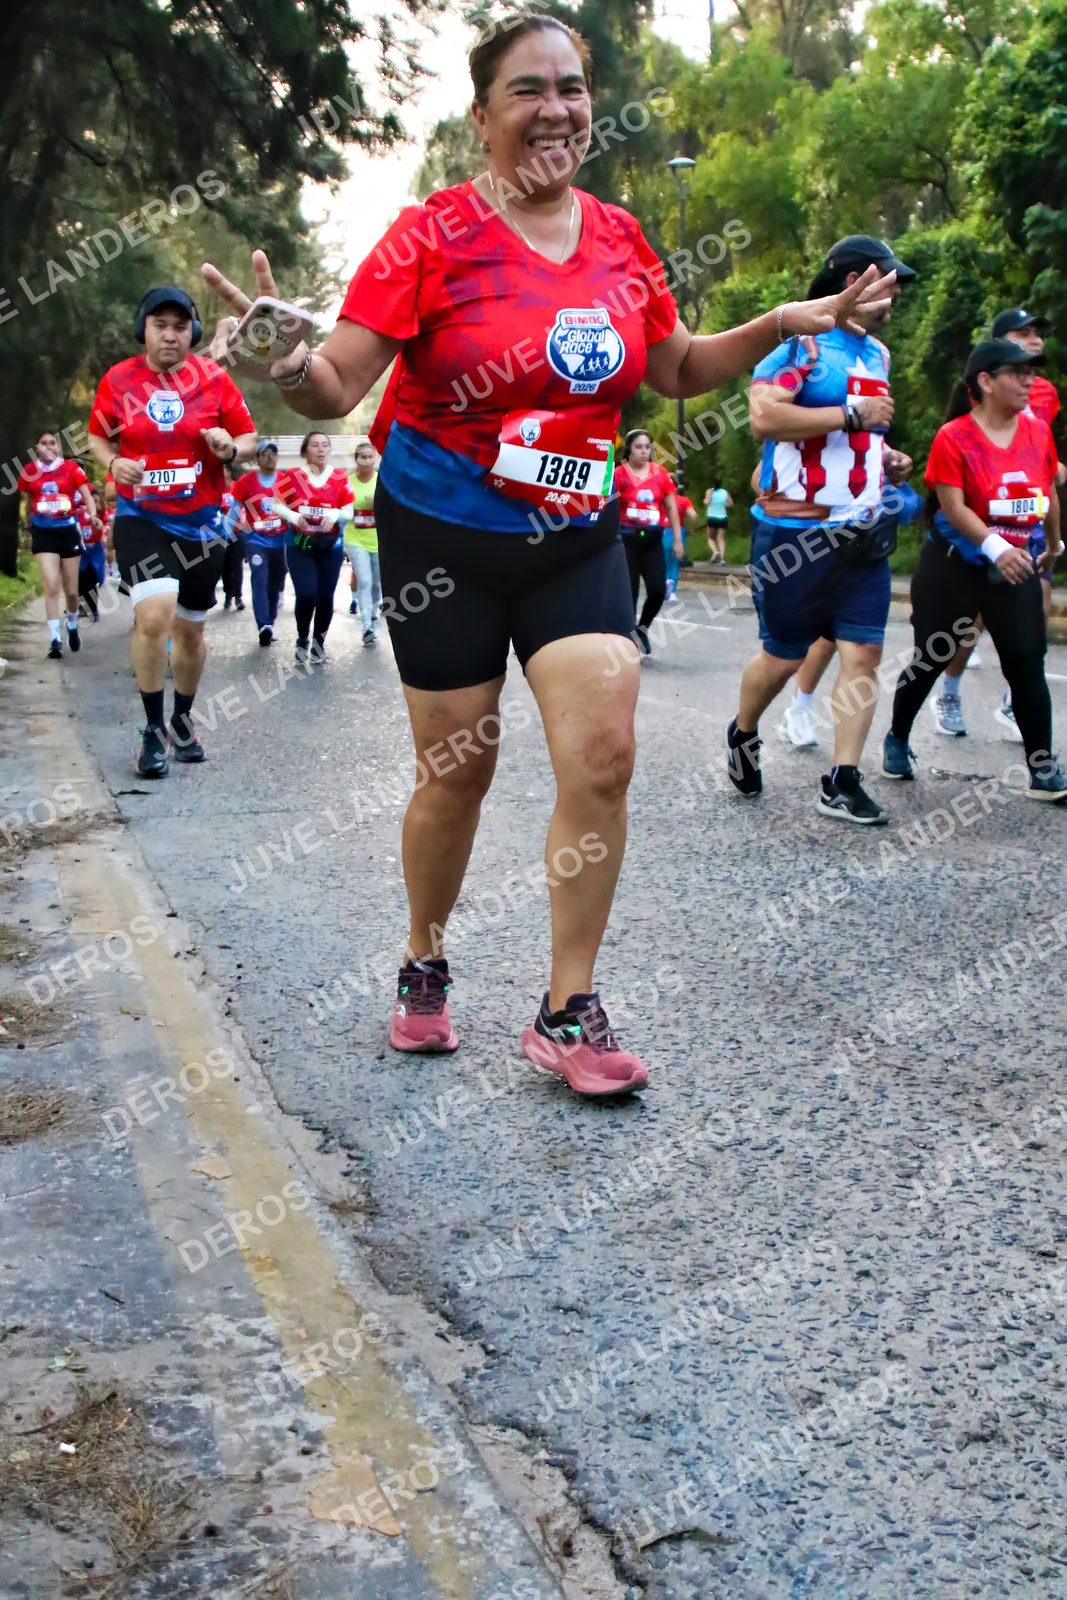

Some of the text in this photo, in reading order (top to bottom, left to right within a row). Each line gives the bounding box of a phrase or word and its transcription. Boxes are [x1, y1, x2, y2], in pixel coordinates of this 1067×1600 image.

[565, 316, 604, 325] BIMBO
[567, 328, 605, 344] Global
[560, 340, 593, 354] Race
[572, 383, 596, 392] 2026
[150, 470, 176, 484] 2707
[536, 454, 591, 490] 1389
[1011, 499, 1035, 513] 1804
